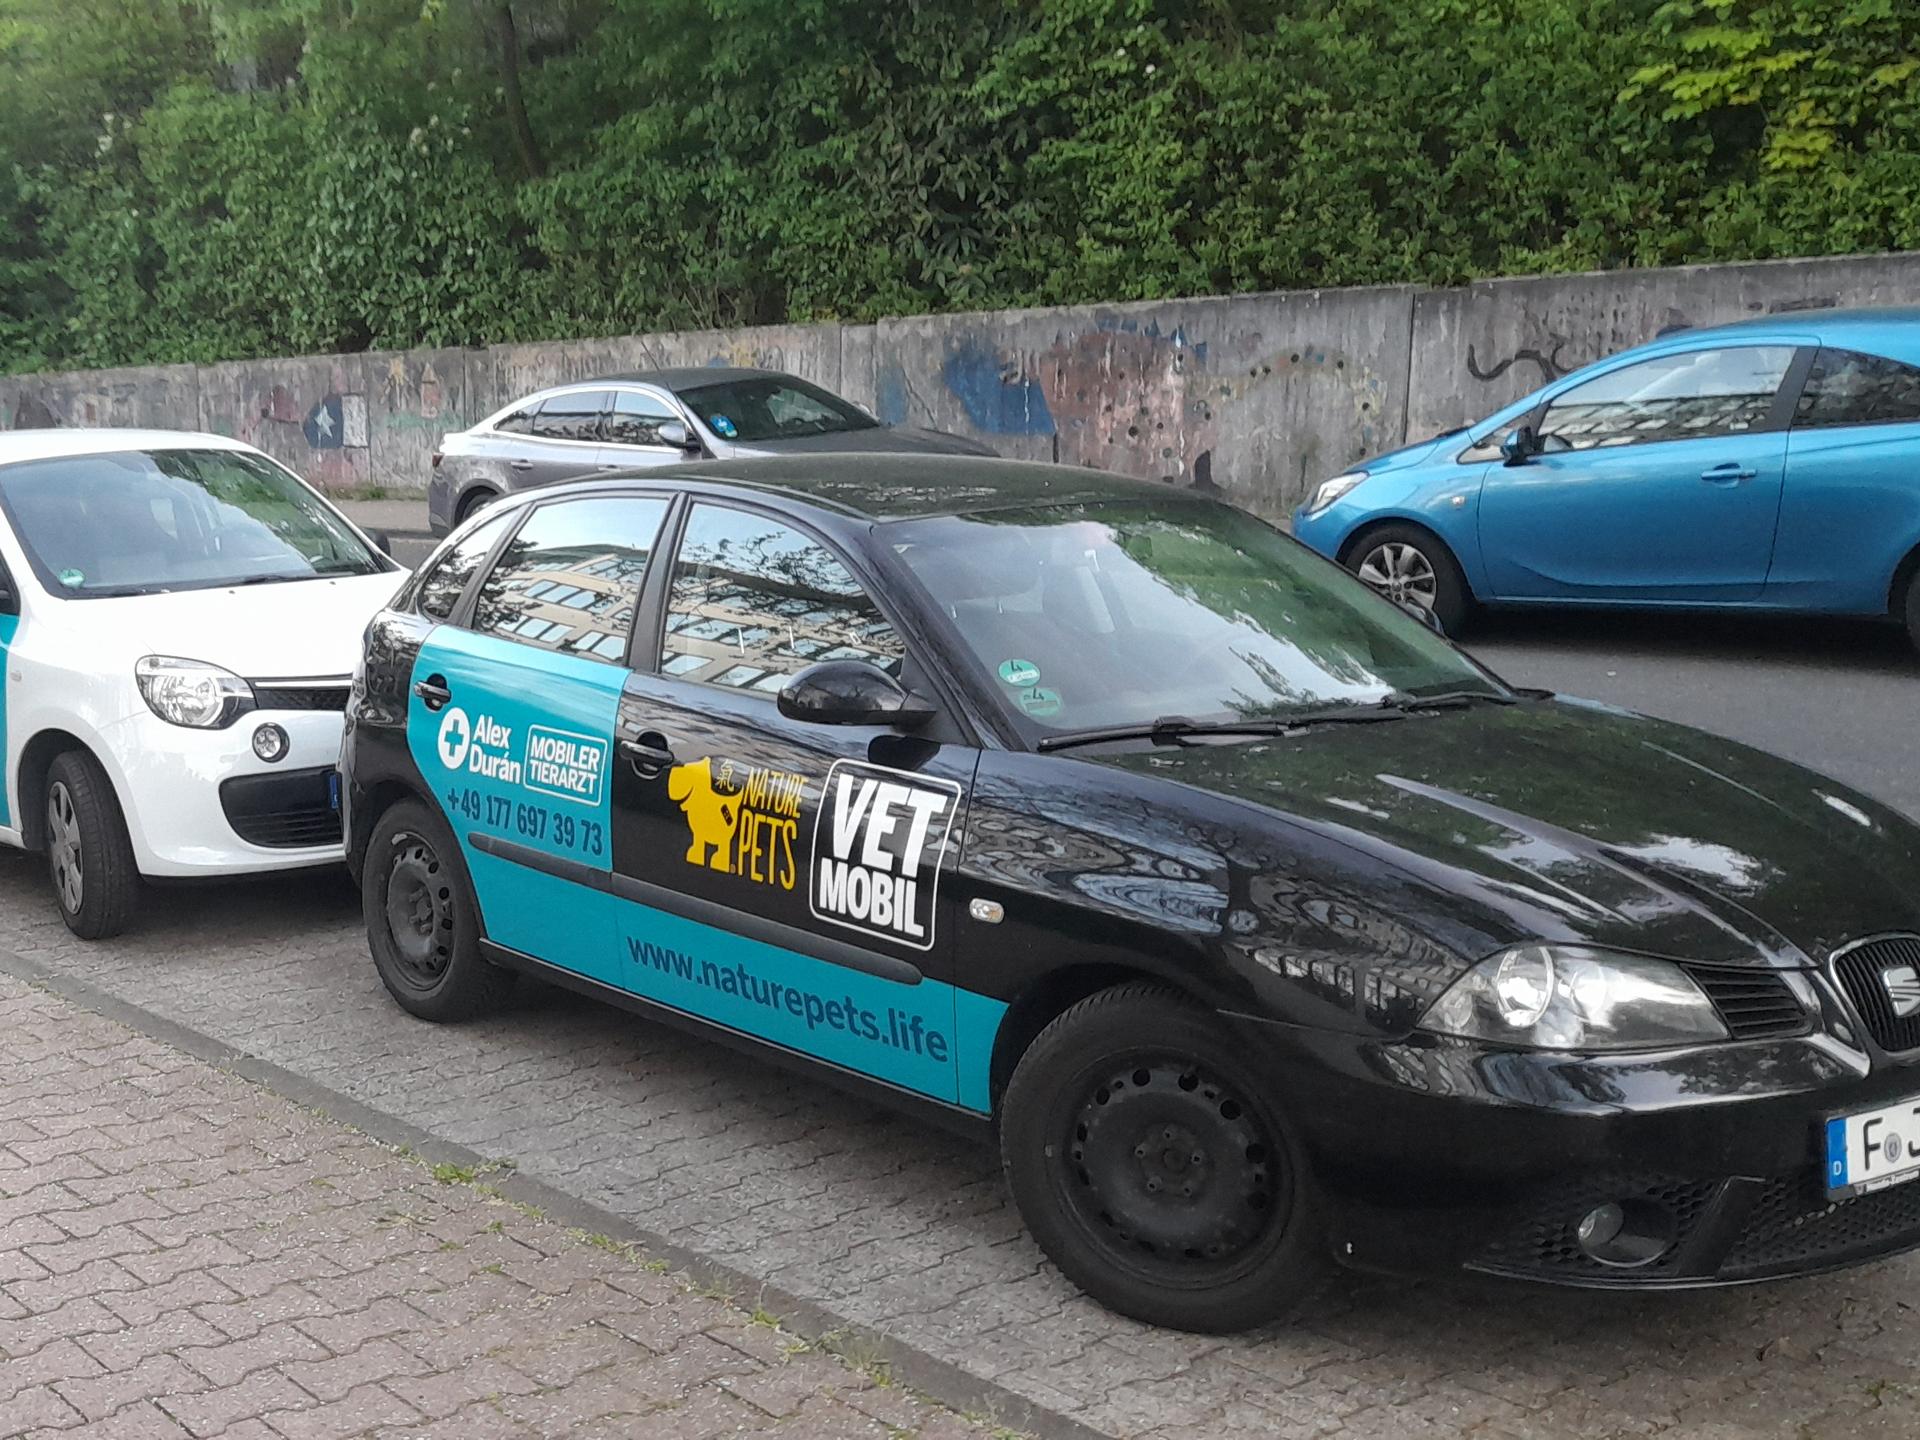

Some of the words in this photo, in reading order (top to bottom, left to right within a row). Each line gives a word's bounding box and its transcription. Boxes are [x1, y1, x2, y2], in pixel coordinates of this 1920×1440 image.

[473, 714, 512, 749] Alex
[530, 736, 600, 773] MOBILER
[469, 744, 521, 784] Durán
[529, 759, 597, 795] TIERARZT
[743, 766, 809, 819] NATURE
[447, 788, 481, 821] +49
[486, 794, 511, 829] 177
[517, 802, 547, 840] 697
[553, 812, 575, 848] 39
[580, 819, 603, 856] 73
[738, 808, 798, 891] PETS
[832, 773, 949, 879] VET
[819, 857, 925, 938] MOBIL
[627, 935, 949, 1063] www.naturepets.life
[1862, 1116, 1883, 1172] F
